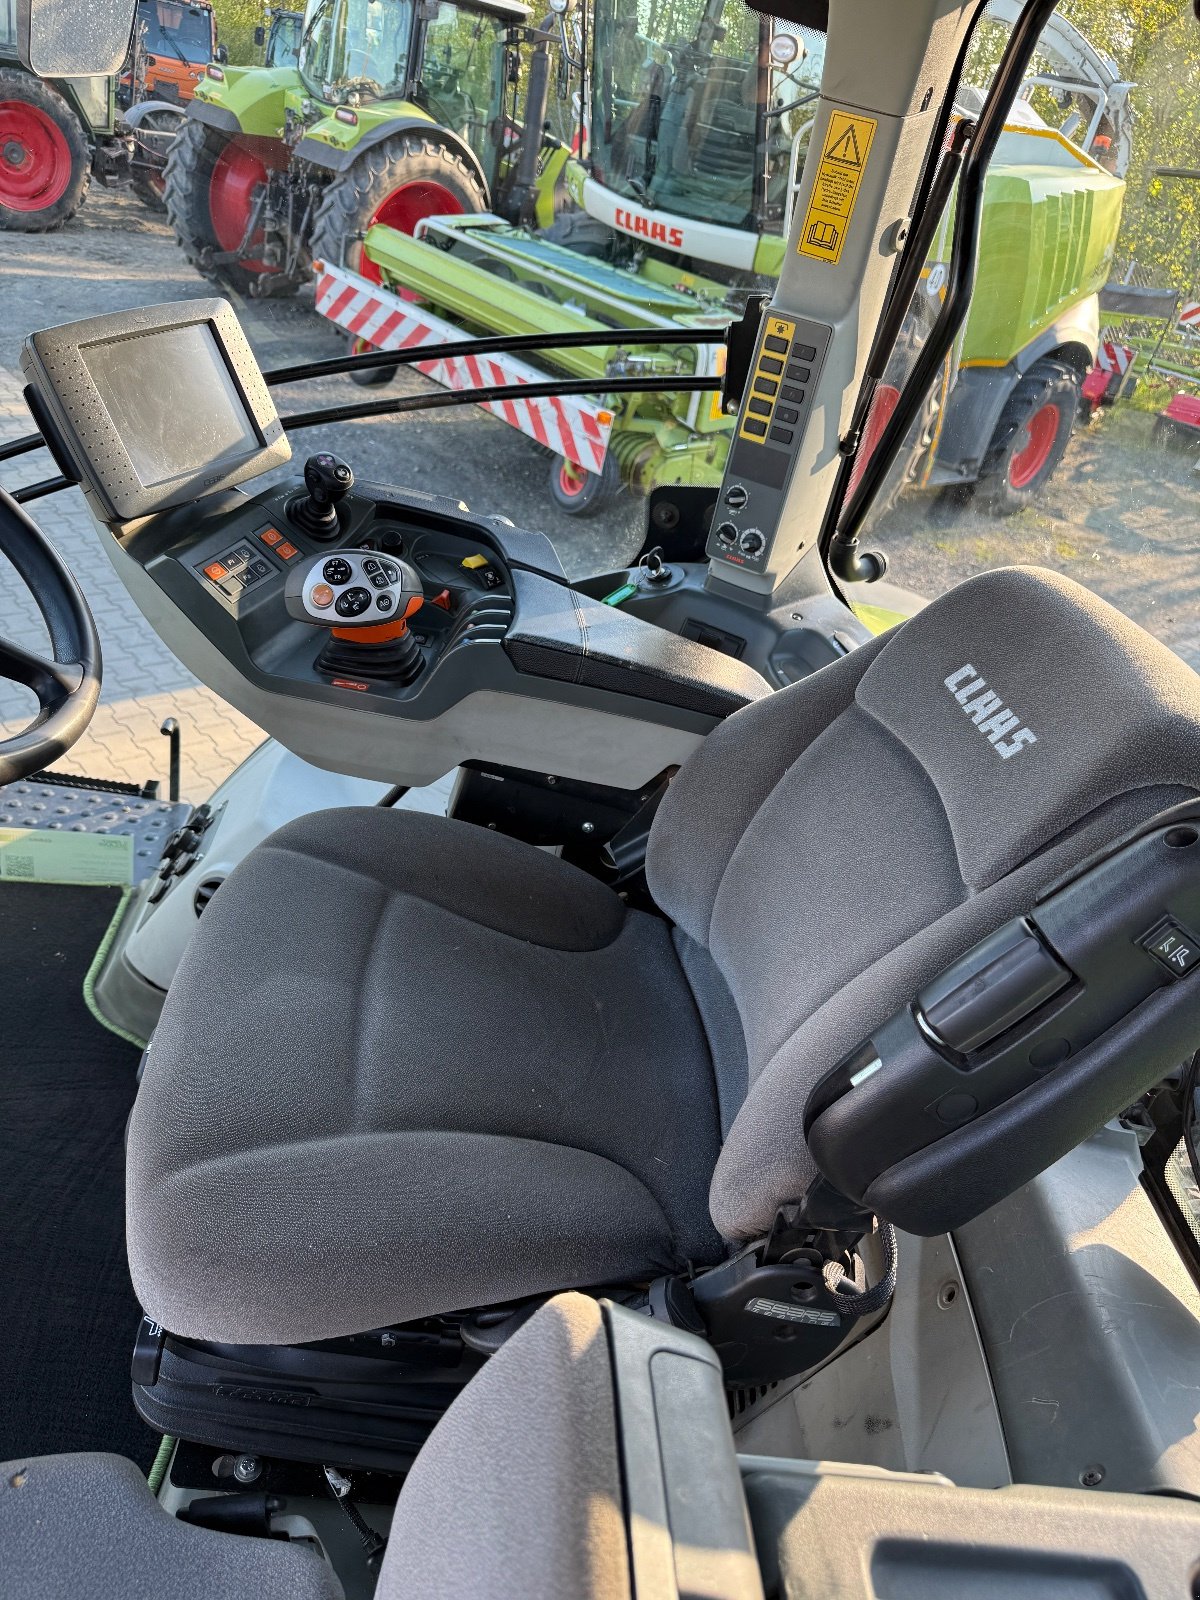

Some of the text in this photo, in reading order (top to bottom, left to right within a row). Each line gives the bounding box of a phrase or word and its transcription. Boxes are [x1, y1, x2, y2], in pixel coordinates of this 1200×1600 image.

[615, 208, 684, 248] CLAAS
[943, 663, 1038, 760] CLAAS
[754, 1299, 838, 1322] SEARS
